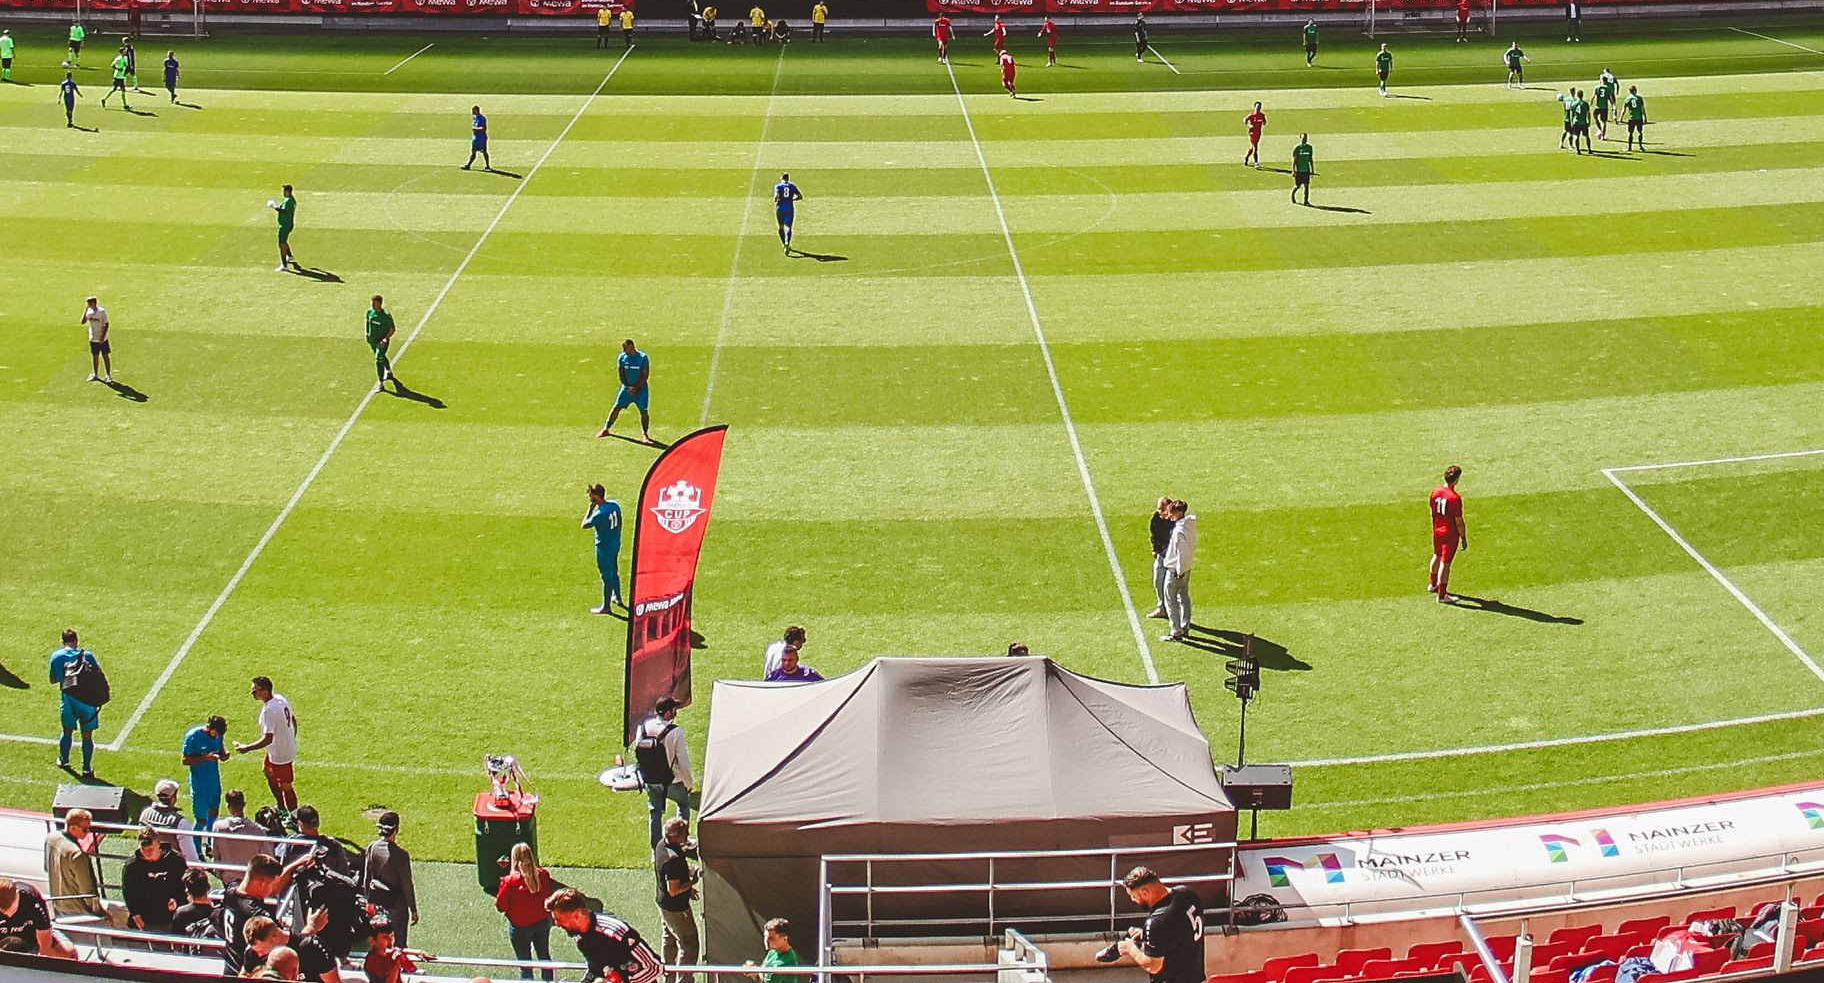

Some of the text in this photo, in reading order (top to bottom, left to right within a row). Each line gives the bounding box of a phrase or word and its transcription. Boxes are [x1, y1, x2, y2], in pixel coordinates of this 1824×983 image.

[783, 186, 791, 198] 8
[664, 510, 691, 519] CUP
[1434, 496, 1447, 516] 11
[608, 511, 619, 530] 11
[1629, 820, 1736, 842] MAINZER
[1358, 850, 1471, 869] MAINZER
[1186, 904, 1203, 942] 5
